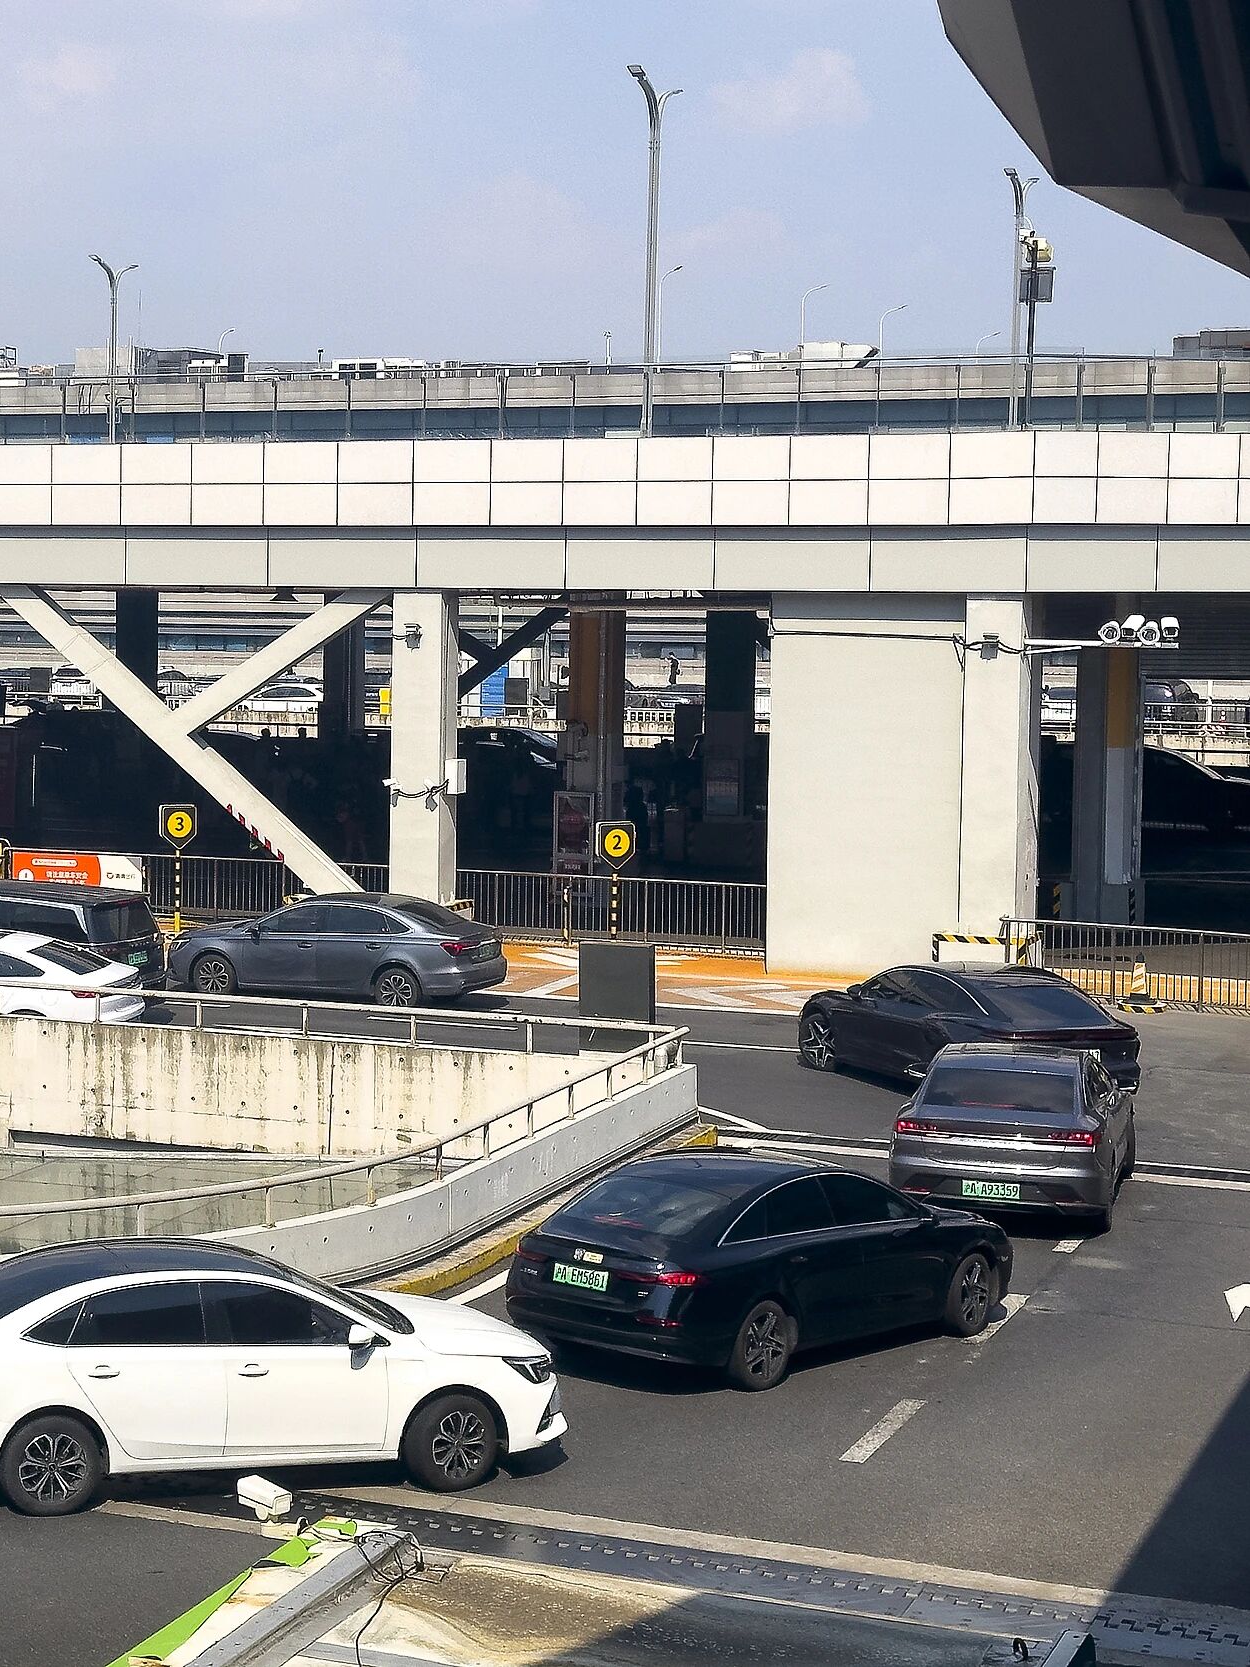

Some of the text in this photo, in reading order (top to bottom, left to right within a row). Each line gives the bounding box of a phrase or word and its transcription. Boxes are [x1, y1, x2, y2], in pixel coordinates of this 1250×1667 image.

[175, 817, 184, 832] 3
[612, 835, 622, 851] 2
[570, 1267, 607, 1289] EM5861
